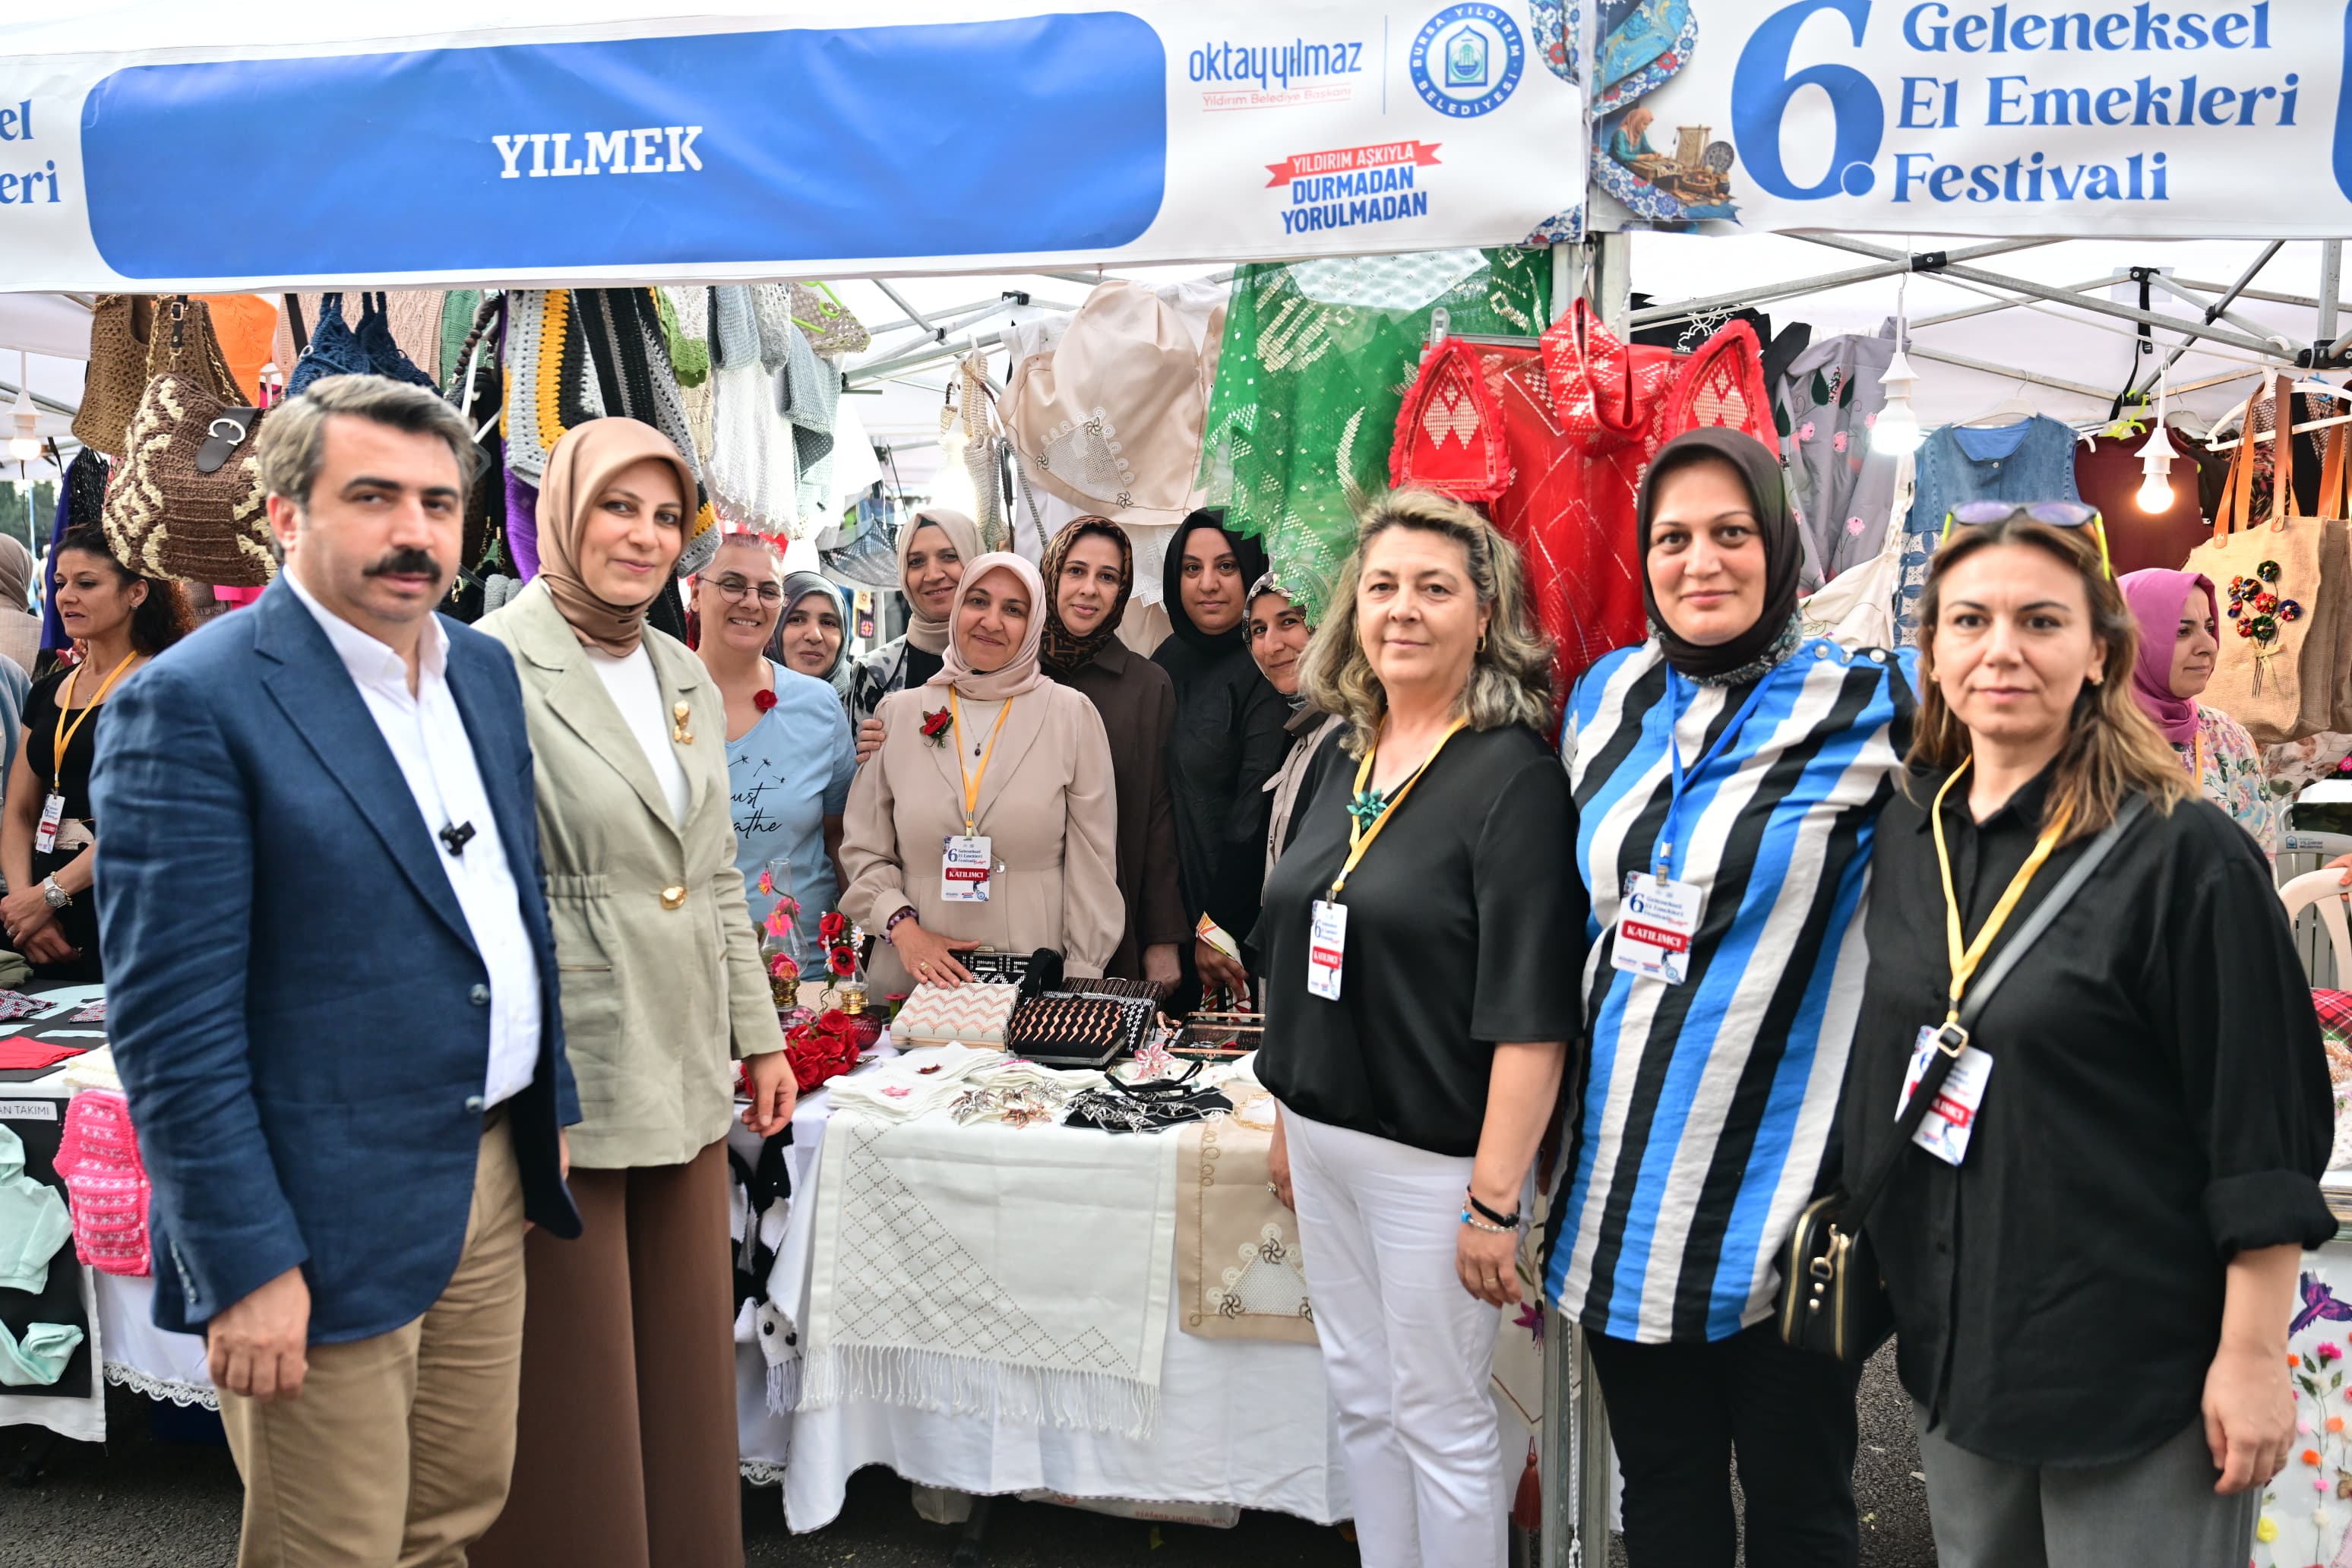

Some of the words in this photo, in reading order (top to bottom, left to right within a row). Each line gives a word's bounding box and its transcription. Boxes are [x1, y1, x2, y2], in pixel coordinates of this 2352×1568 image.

[1412, 17, 1445, 67] BURSA
[1455, 6, 1520, 57] YILDIRIM
[1903, 0, 2270, 53] Geleneksel
[1251, 90, 1301, 105] Belediye
[1897, 77, 1958, 128] El
[1985, 73, 2300, 127] Emekleri
[492, 125, 703, 179] YILMEK
[1293, 151, 1352, 174] YILDIRIM
[1356, 144, 1415, 167] AŞKIYLA
[1293, 165, 1413, 205] DURMADAN
[1892, 152, 2169, 203] Festivali
[1281, 191, 1427, 235] YORULMADAN
[731, 782, 780, 808] ust
[734, 807, 782, 839] athe
[948, 848, 957, 861] 6
[1630, 893, 1644, 913] 6
[1314, 918, 1321, 937] 6
[1626, 925, 1681, 947] KATILIMCI
[14, 1105, 49, 1115] TAKIMI
